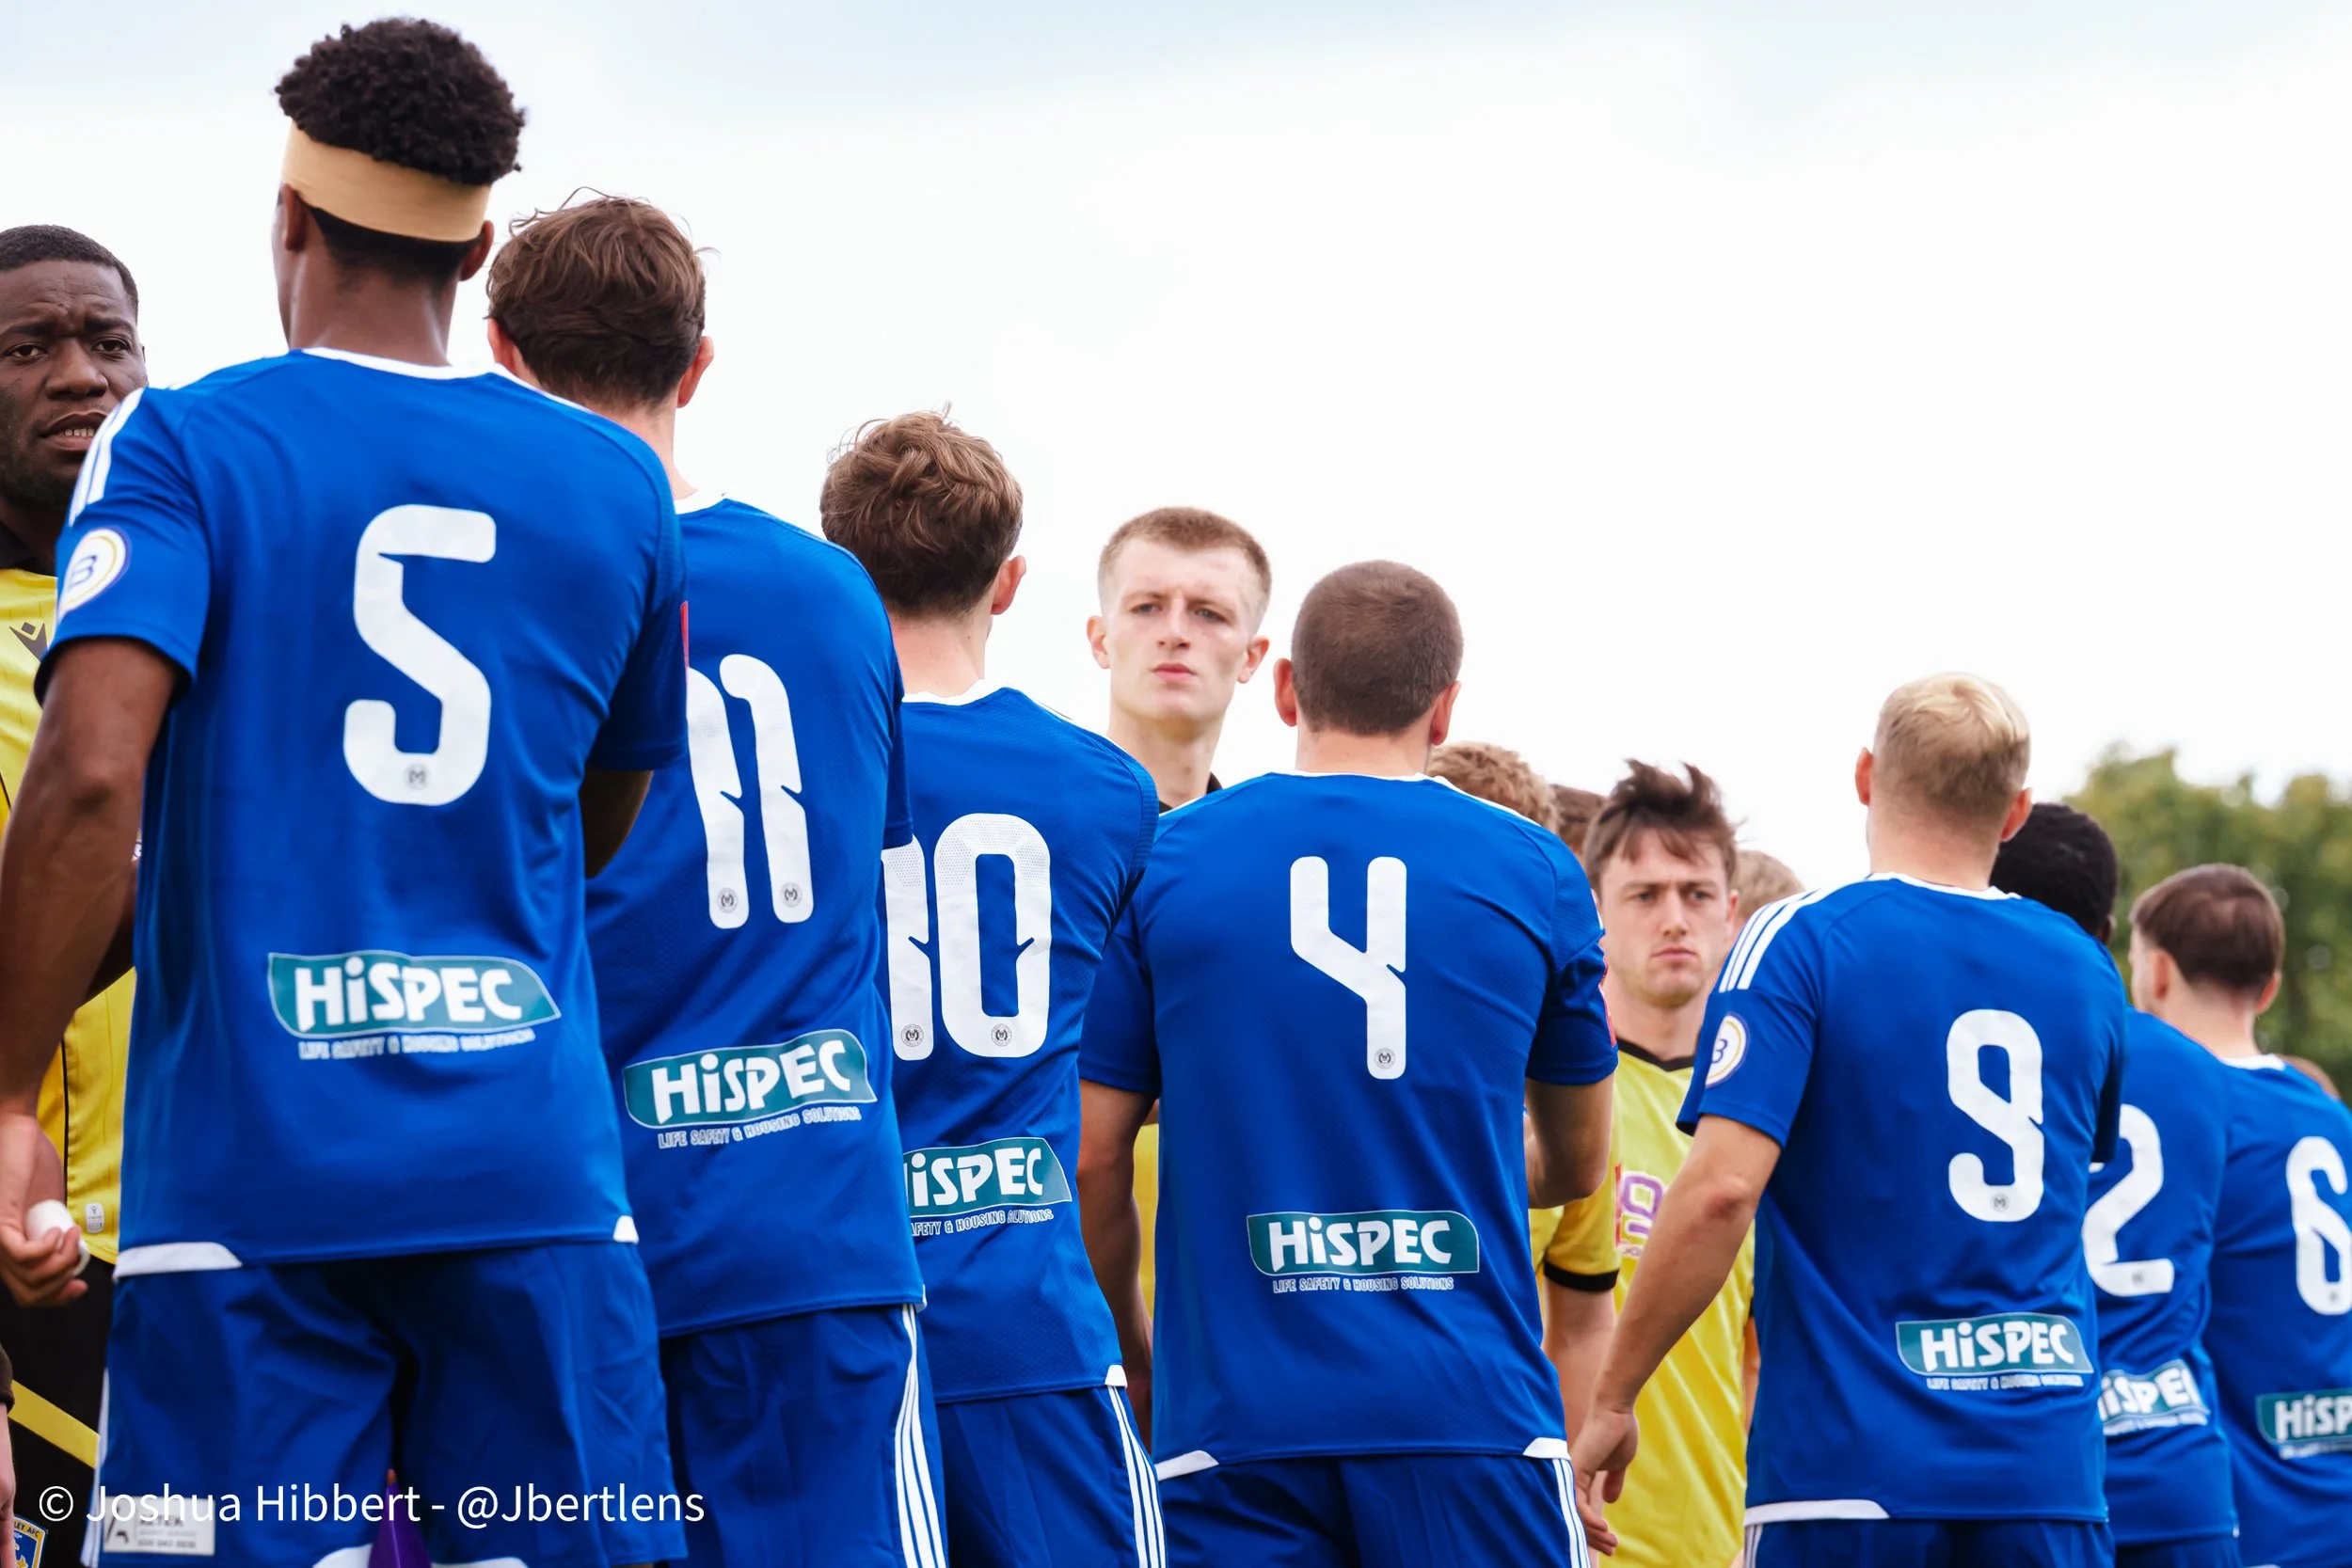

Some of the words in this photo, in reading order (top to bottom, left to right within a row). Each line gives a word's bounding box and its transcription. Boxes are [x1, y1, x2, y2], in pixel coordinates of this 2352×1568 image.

[343, 504, 497, 806] 5
[688, 654, 814, 928] 11
[881, 813, 1052, 1061] 10
[1290, 856, 1406, 1080] 4
[294, 957, 522, 1033] HiSPEC
[652, 1040, 850, 1125] HiSPEC
[1947, 1009, 2044, 1222] 9
[659, 1130, 688, 1148] LIFE
[691, 1128, 730, 1146] SAFETY
[732, 1126, 743, 1141] &
[746, 1114, 800, 1139] HOUSING
[903, 1148, 1042, 1207] iSPEC
[2083, 1104, 2174, 1297] 2
[911, 1222, 942, 1237] FETY
[945, 1221, 954, 1233] &
[957, 1211, 1006, 1232] HOUSING
[1269, 1217, 1452, 1272] HiSPEC
[2286, 1136, 2352, 1315] 6
[1273, 1278, 1296, 1293] LIFE
[1299, 1277, 1340, 1291] SAFETY
[1343, 1279, 1351, 1291] &
[1354, 1277, 1398, 1292] HOUSING
[1401, 1276, 1454, 1291] SOLUTIONS
[1920, 1322, 2074, 1372] HiSPEC
[2275, 1394, 2352, 1443] HiSP
